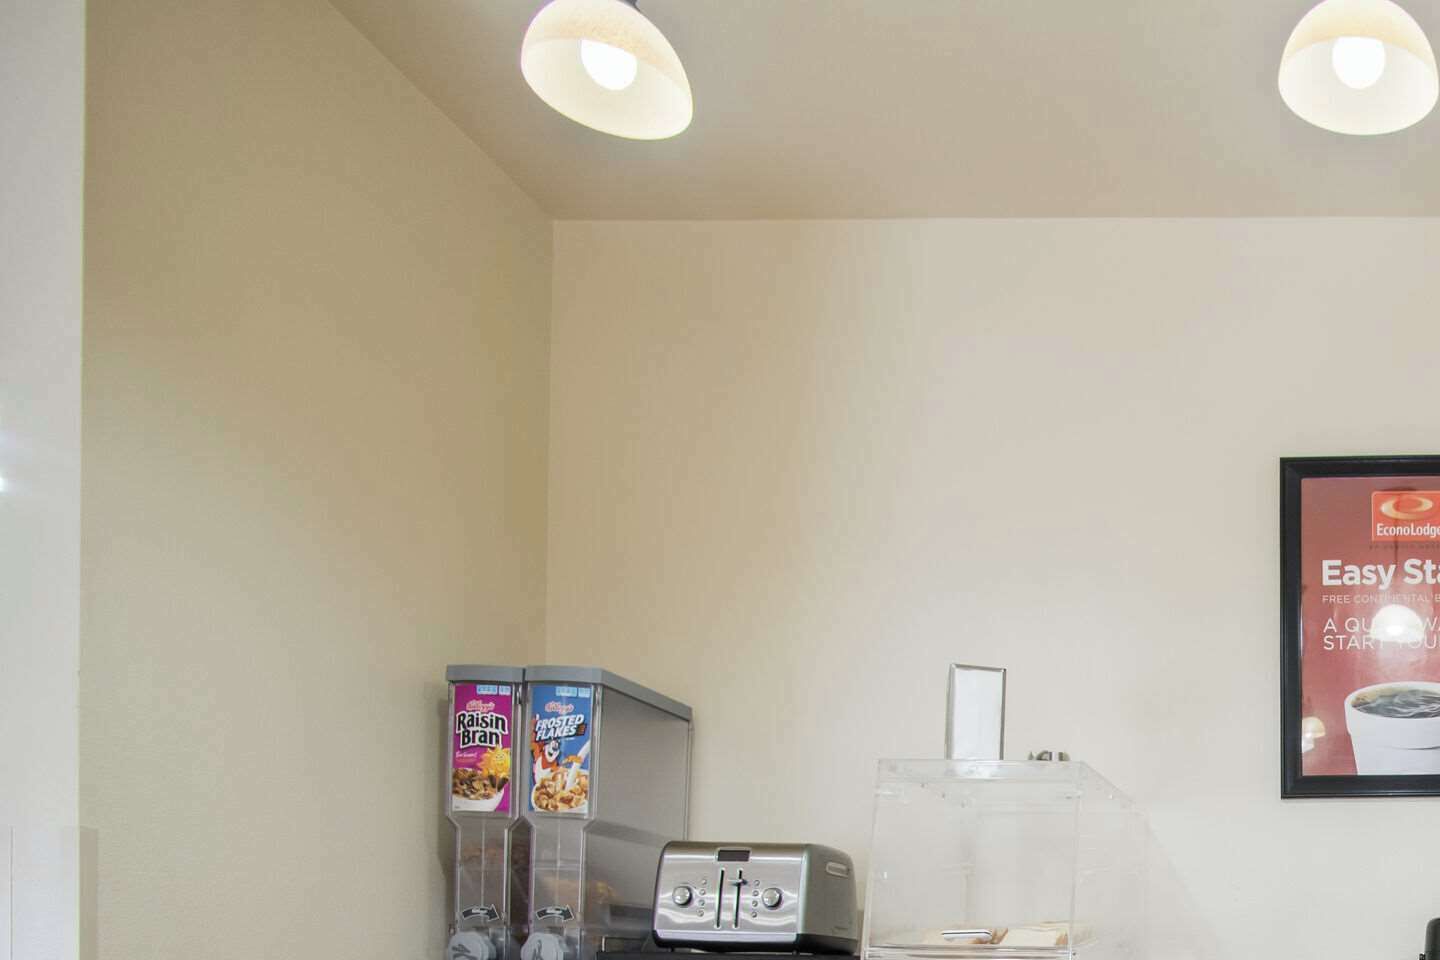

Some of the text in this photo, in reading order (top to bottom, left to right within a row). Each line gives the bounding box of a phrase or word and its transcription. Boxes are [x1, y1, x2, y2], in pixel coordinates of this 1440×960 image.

[1321, 559, 1397, 591] Easy
[1322, 594, 1350, 604] FREE
[1323, 617, 1338, 633] A
[455, 710, 508, 735] Raisin
[536, 714, 585, 732] FROSTED
[460, 728, 502, 749] Bran
[536, 725, 577, 742] FLAKES
